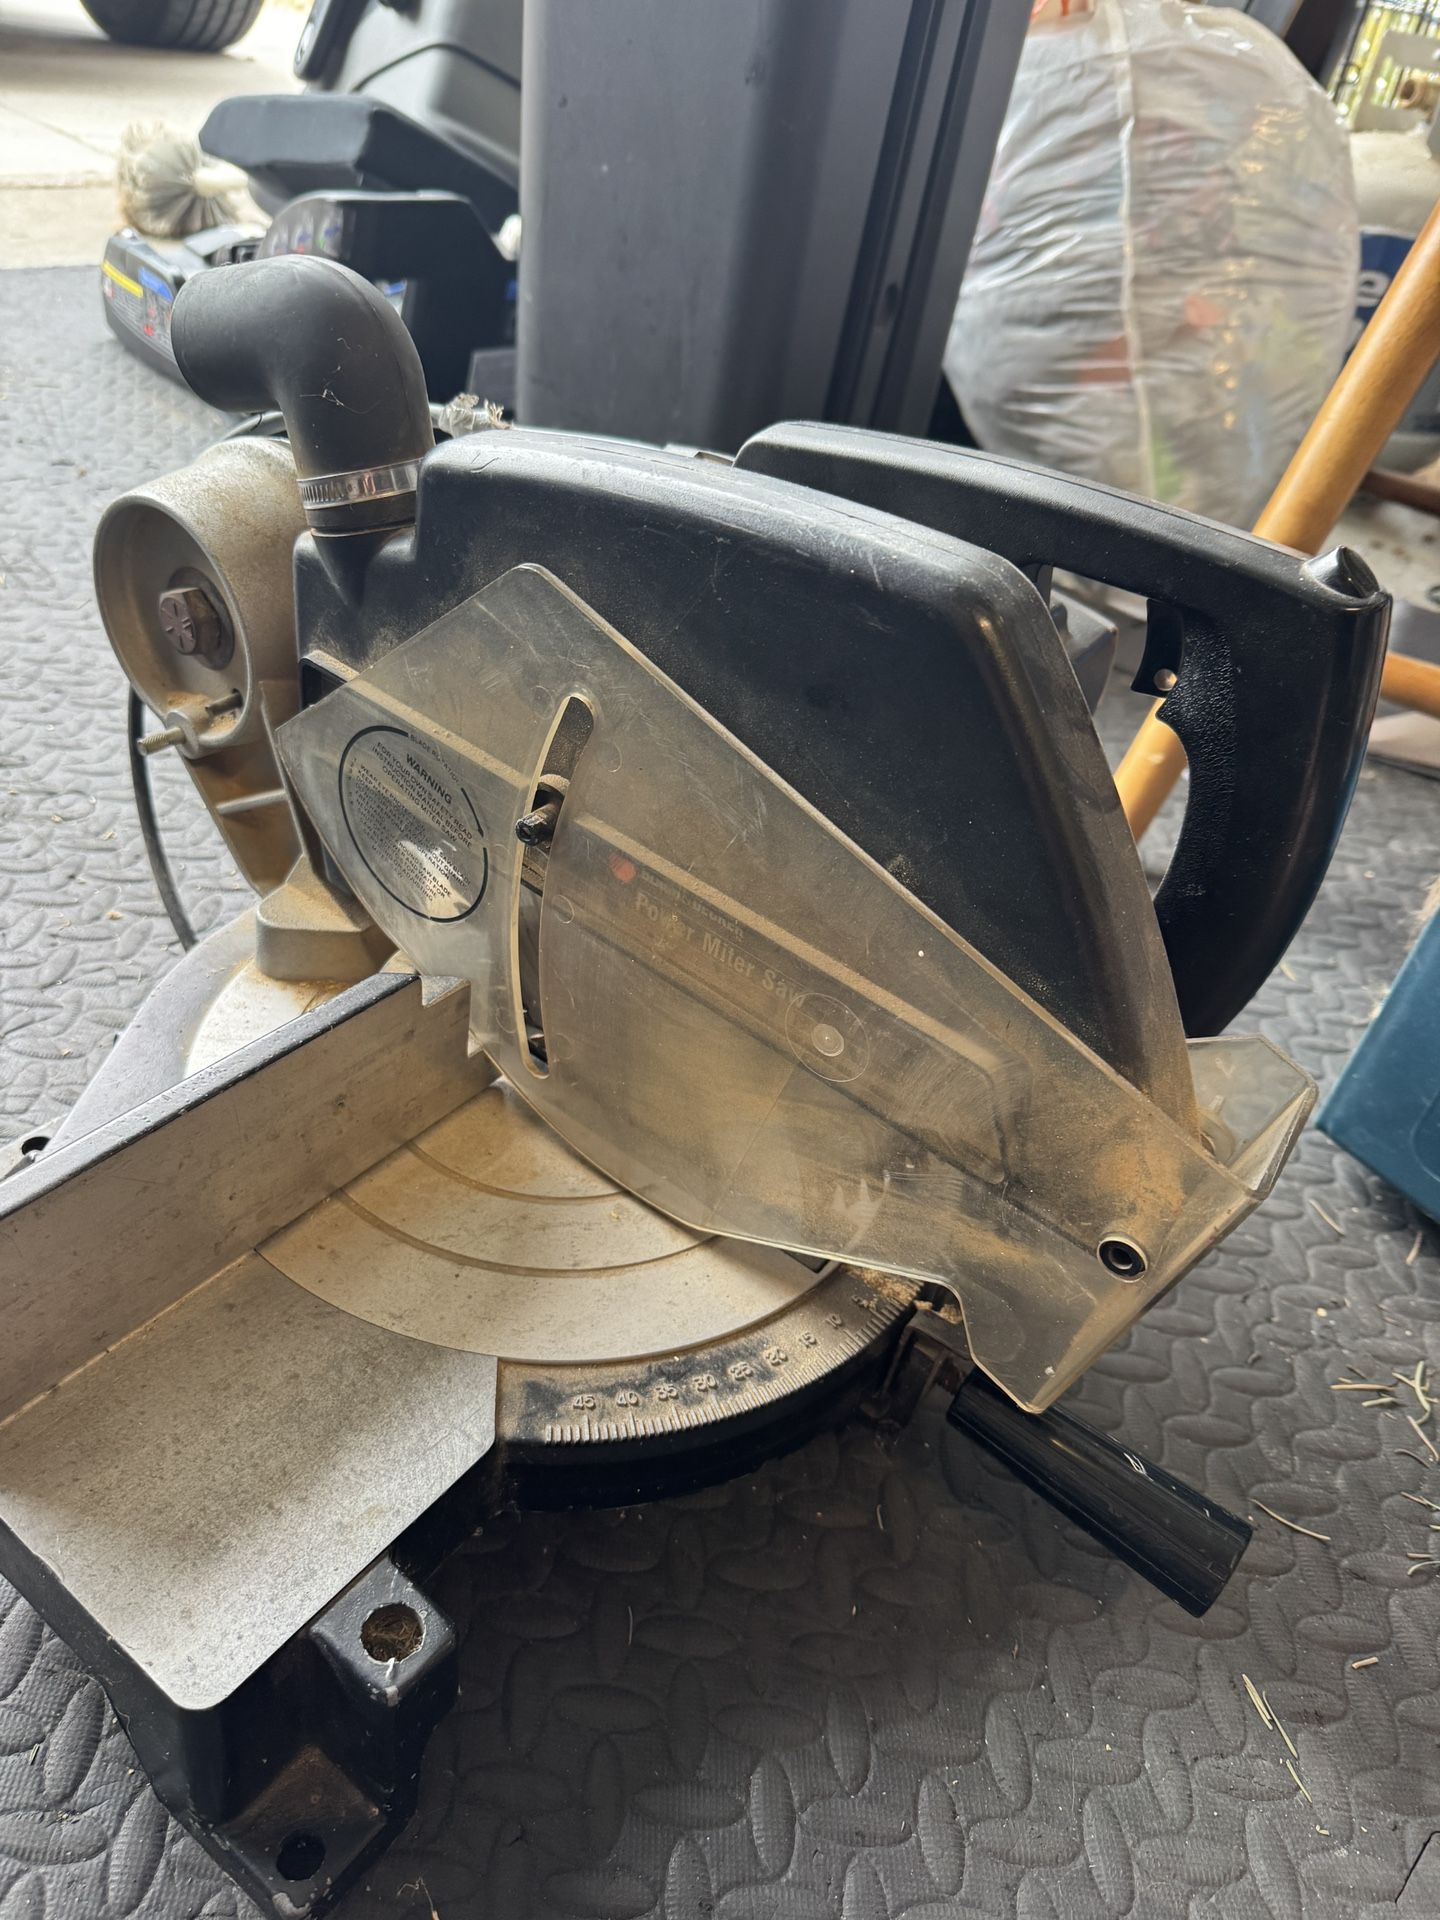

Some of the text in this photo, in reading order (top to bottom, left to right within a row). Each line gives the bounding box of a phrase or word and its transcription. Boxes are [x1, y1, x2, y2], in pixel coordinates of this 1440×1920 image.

[371, 746, 415, 792] INSTRUCTION
[415, 790, 444, 821] MANUAL
[444, 819, 472, 849] BEFORE
[376, 741, 391, 758] FOR
[390, 755, 410, 778] YOUR
[410, 774, 427, 794] OWN
[426, 791, 453, 820] SAFETY
[452, 817, 473, 840] READ
[381, 765, 420, 806] OPERATING
[419, 803, 441, 827] MITER
[440, 824, 457, 843] SAW
[405, 754, 452, 804] WARNING
[431, 874, 451, 896] BLADE
[633, 891, 807, 1008] Power Miter Saw
[573, 1394, 596, 1410] 45
[617, 1391, 639, 1406] 40
[655, 1383, 679, 1400] 35
[693, 1374, 717, 1392] 30
[729, 1361, 753, 1381] 25
[765, 1347, 788, 1367] 20
[799, 1332, 817, 1349] 15
[825, 1313, 843, 1330] 10
